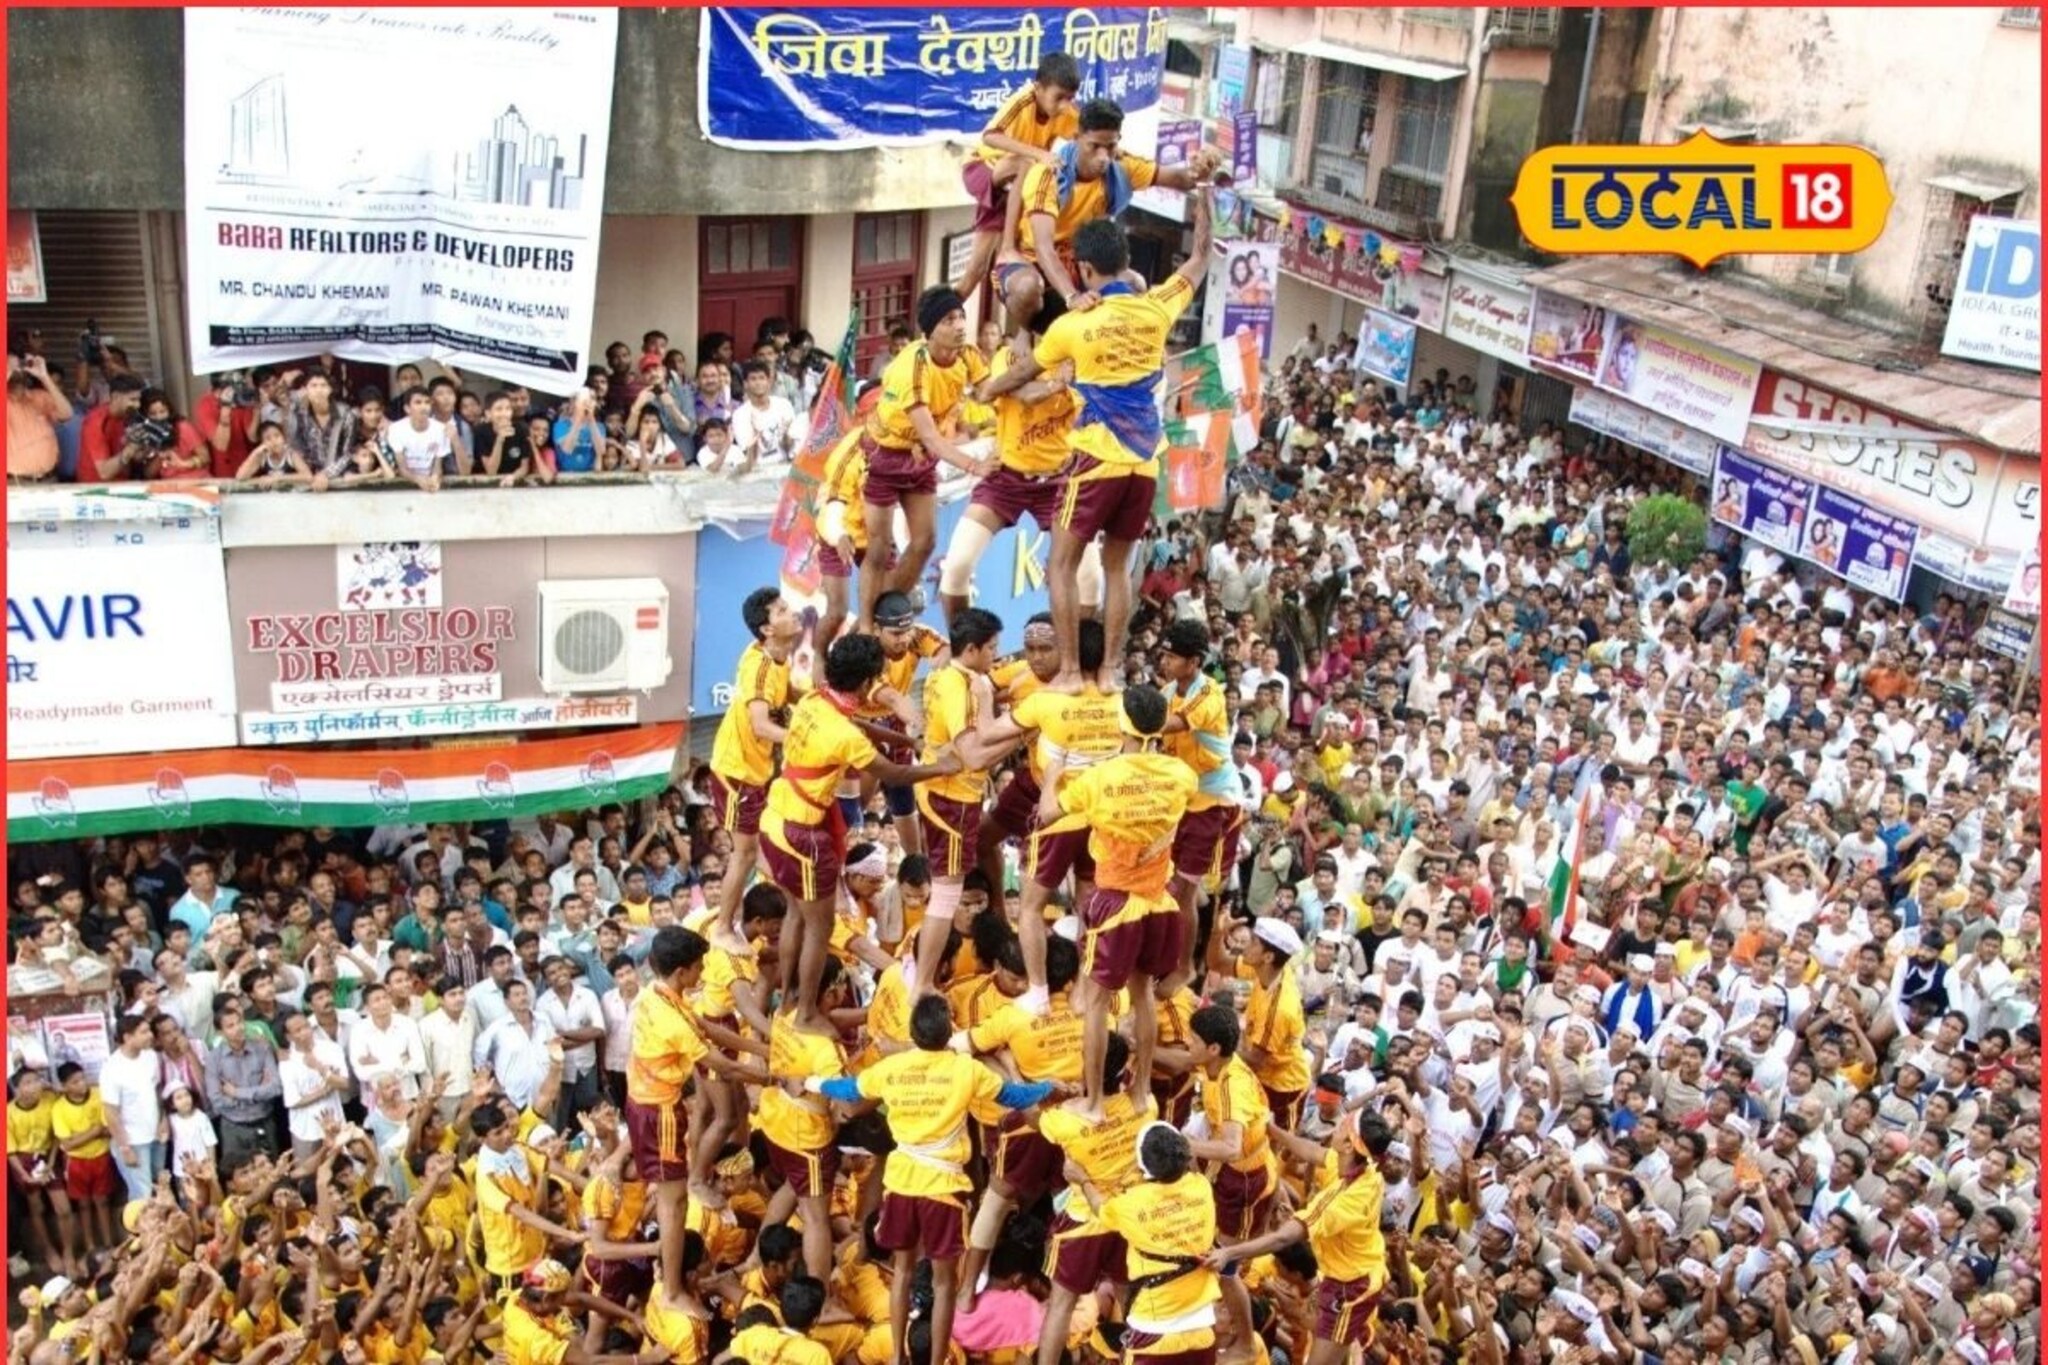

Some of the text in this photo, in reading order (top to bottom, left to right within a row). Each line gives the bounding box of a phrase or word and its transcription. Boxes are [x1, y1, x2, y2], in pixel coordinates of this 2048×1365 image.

[918, 8, 1044, 77] देवशी
[1063, 7, 1140, 63] निवास
[290, 227, 407, 254] REALTORS
[412, 230, 428, 251] &
[434, 232, 574, 273] DEVELOPERS
[220, 280, 390, 300] MR. CHANDU KHEMANI
[422, 283, 570, 321] MR. PAWAN KHEMANI
[1962, 297, 2006, 316] IDEAL
[1957, 337, 1995, 353] Health
[1767, 378, 1978, 508] STORES
[247, 607, 515, 652] EXCELSIOR
[277, 642, 498, 684] DRAPERS
[9, 696, 214, 722] Readymade Garment
